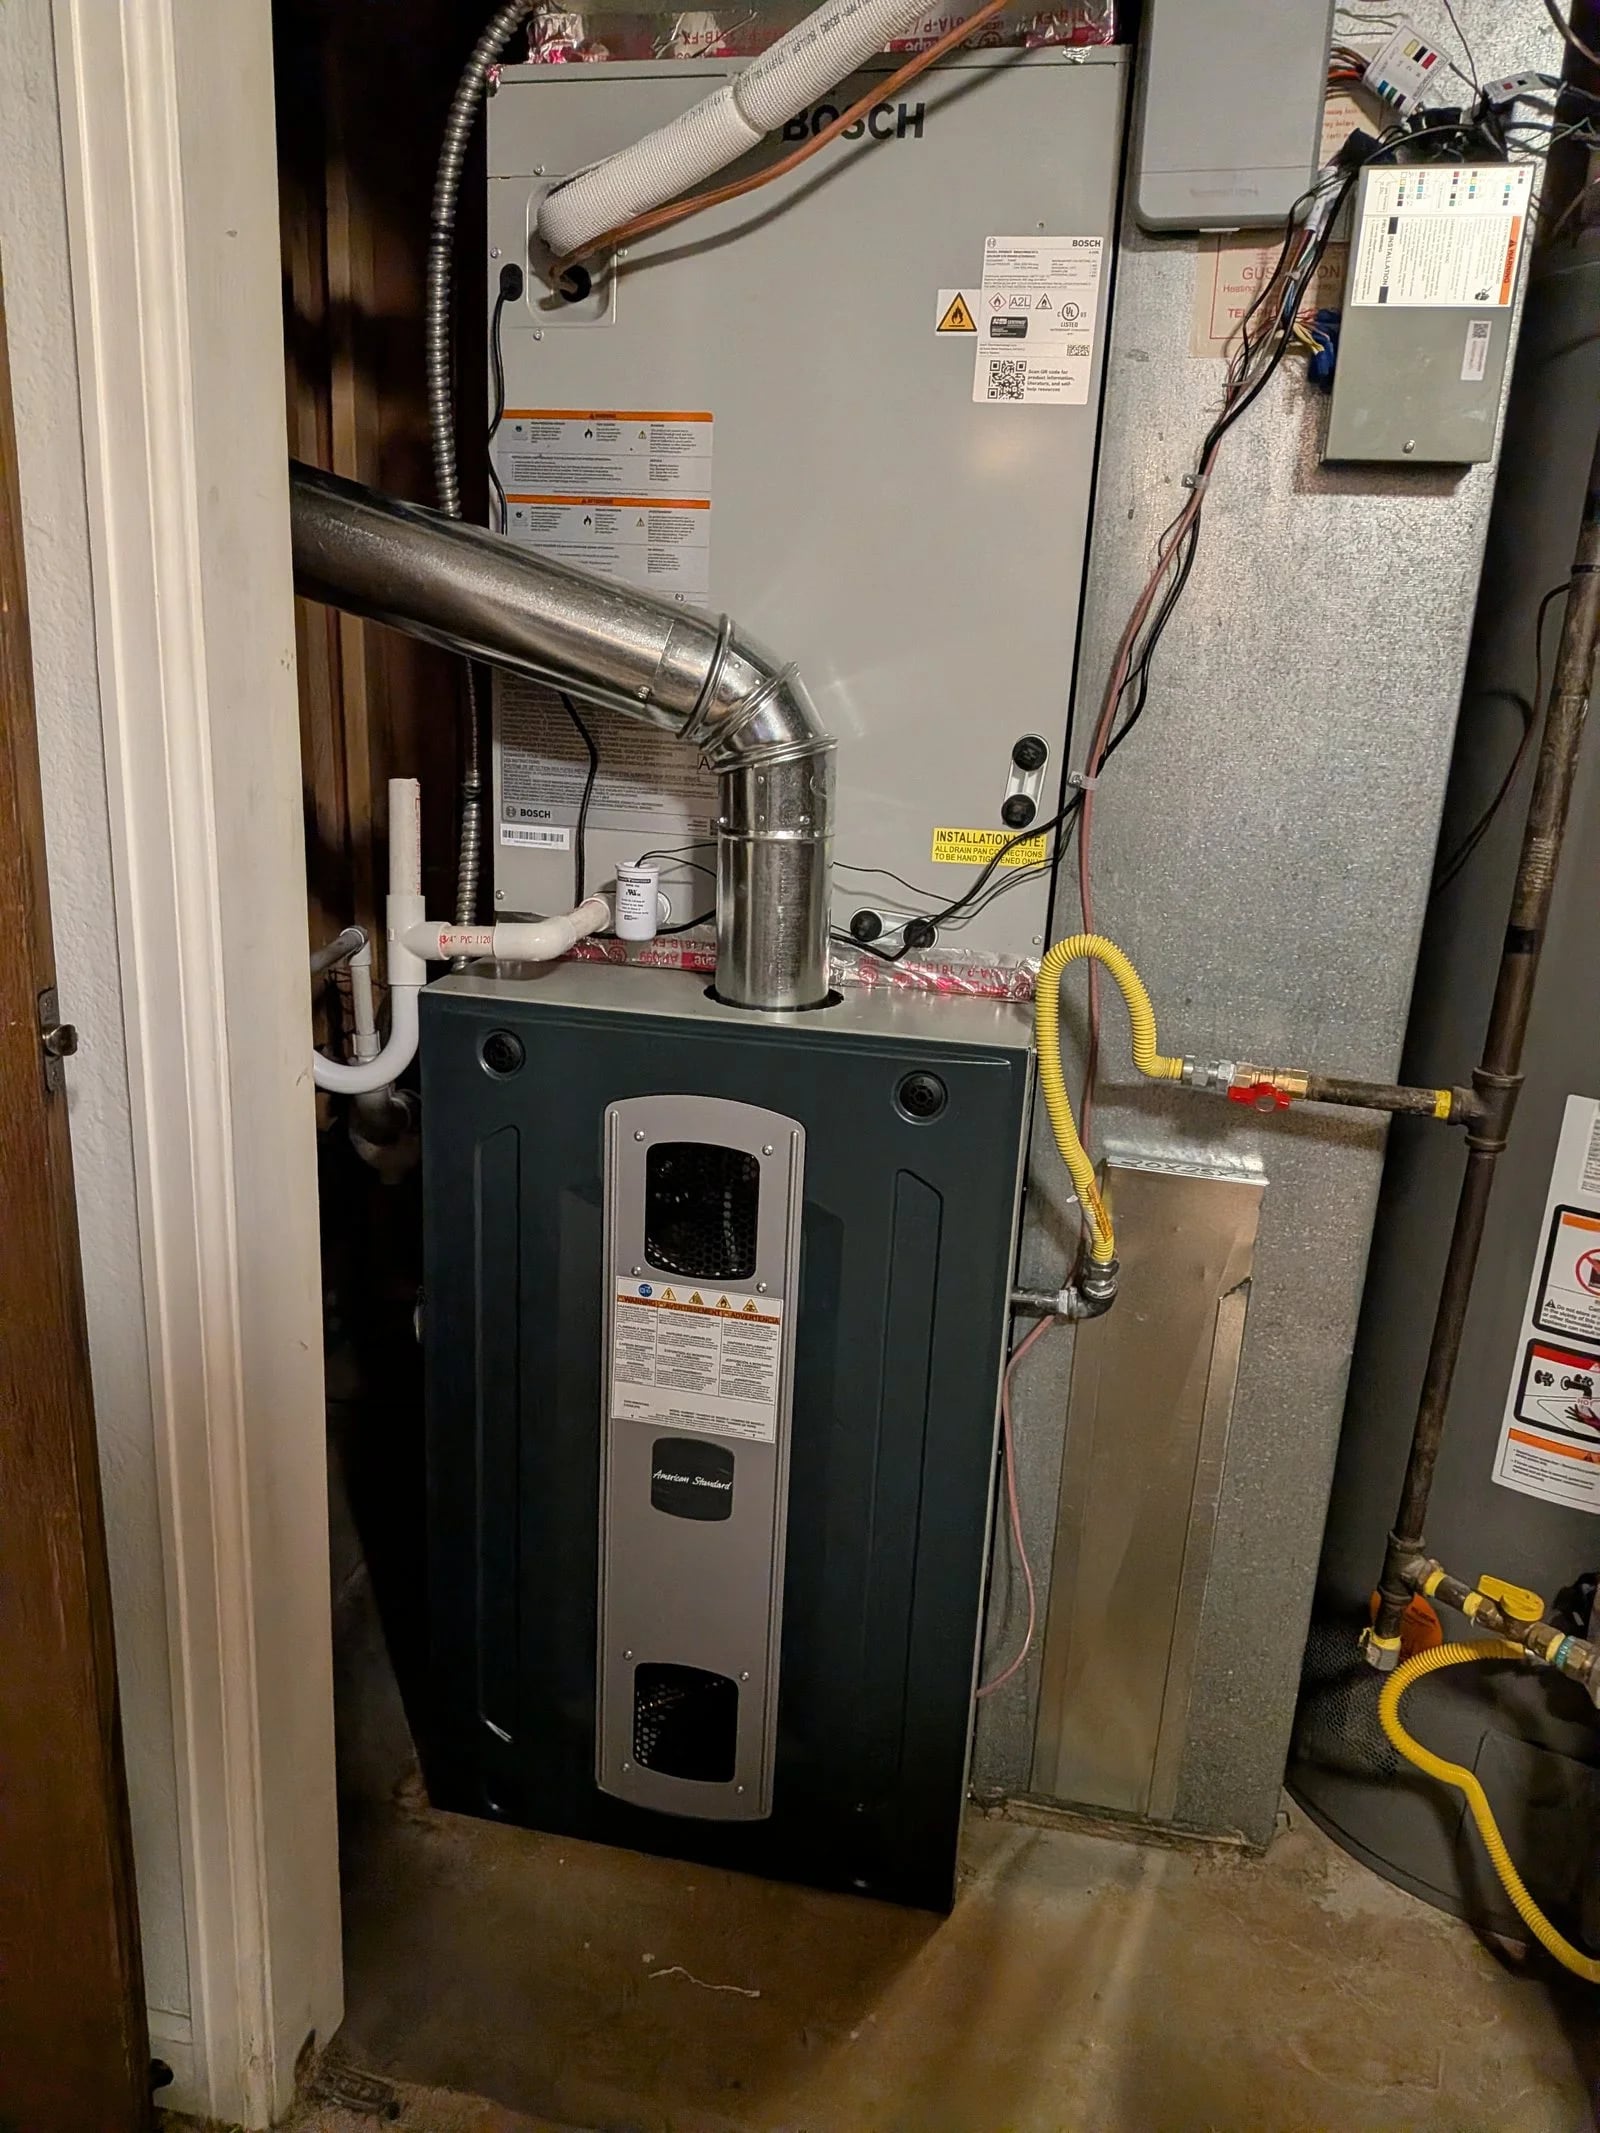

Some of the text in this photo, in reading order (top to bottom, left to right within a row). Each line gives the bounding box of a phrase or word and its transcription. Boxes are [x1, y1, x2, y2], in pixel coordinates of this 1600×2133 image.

[1072, 239, 1101, 247] BOSCH
[1382, 236, 1394, 286] INSTALLATION
[1503, 249, 1515, 284] WARNING
[1011, 297, 1029, 307] A2L
[520, 808, 551, 819] BOSCH
[936, 830, 1010, 845] INSTALLATION
[949, 846, 972, 854] DRAIN
[989, 849, 1043, 858] COECTIONS
[957, 854, 977, 862] HAND
[979, 856, 1020, 865] TIGENED
[460, 935, 472, 944] PVC
[476, 935, 491, 944] 1120
[624, 1295, 779, 1324] WARNING AVERTISSEMENT ADVERTENCIA
[1577, 1398, 1593, 1407] HOT
[653, 1469, 732, 1490] American Standard
